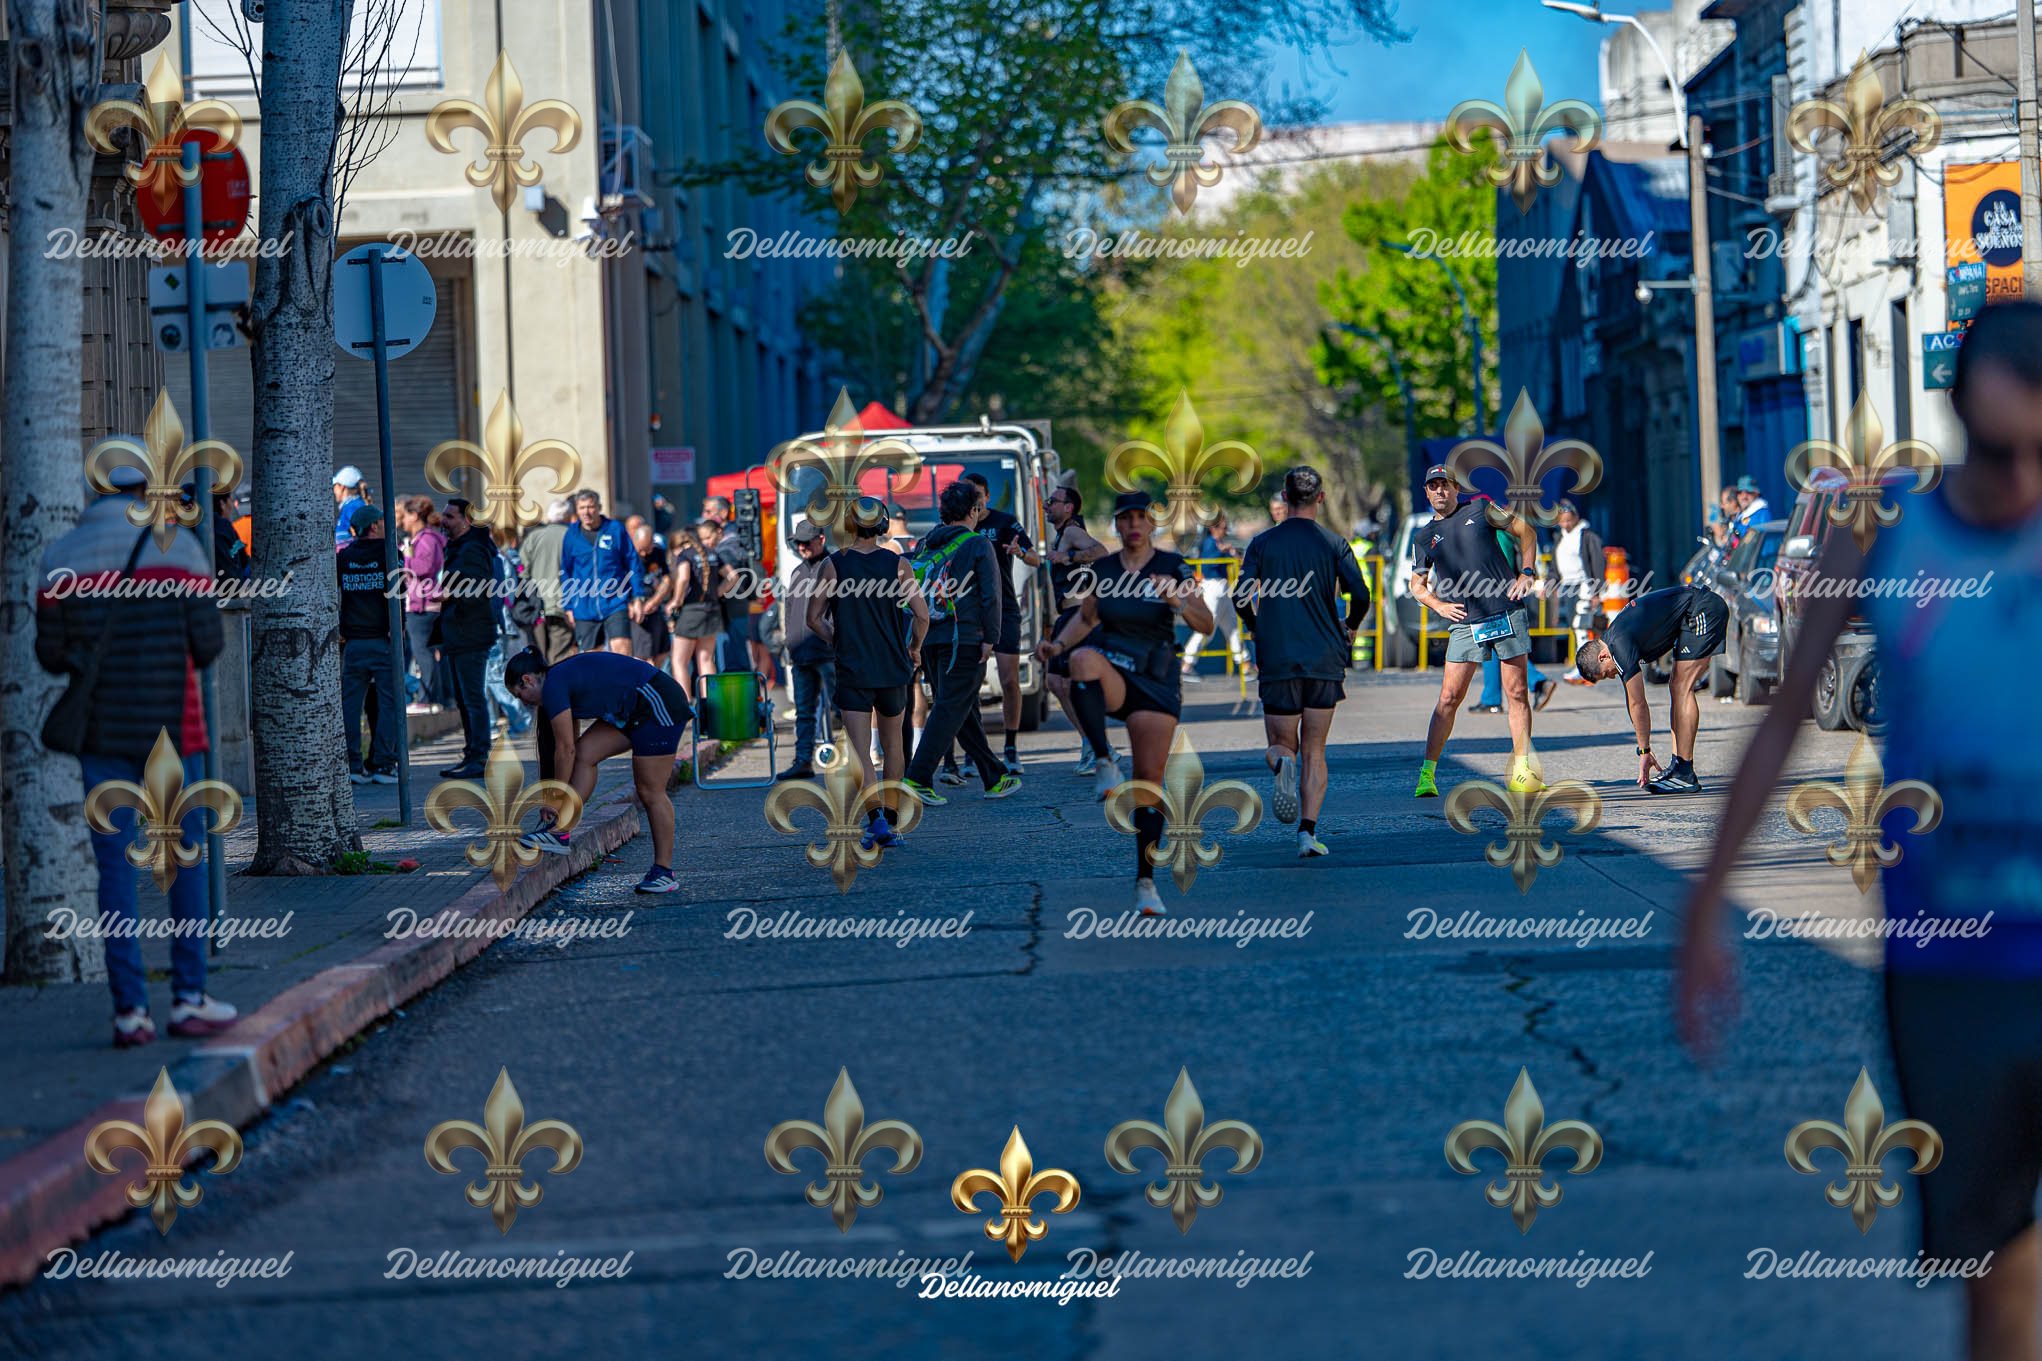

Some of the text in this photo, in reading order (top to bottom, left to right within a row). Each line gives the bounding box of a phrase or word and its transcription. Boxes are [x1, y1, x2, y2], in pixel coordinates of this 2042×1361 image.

[1984, 209, 2018, 226] CASA
[1986, 277, 2023, 294] SPACI
[342, 572, 384, 583] RUSTICOS
[343, 580, 384, 591] RUNNERS
